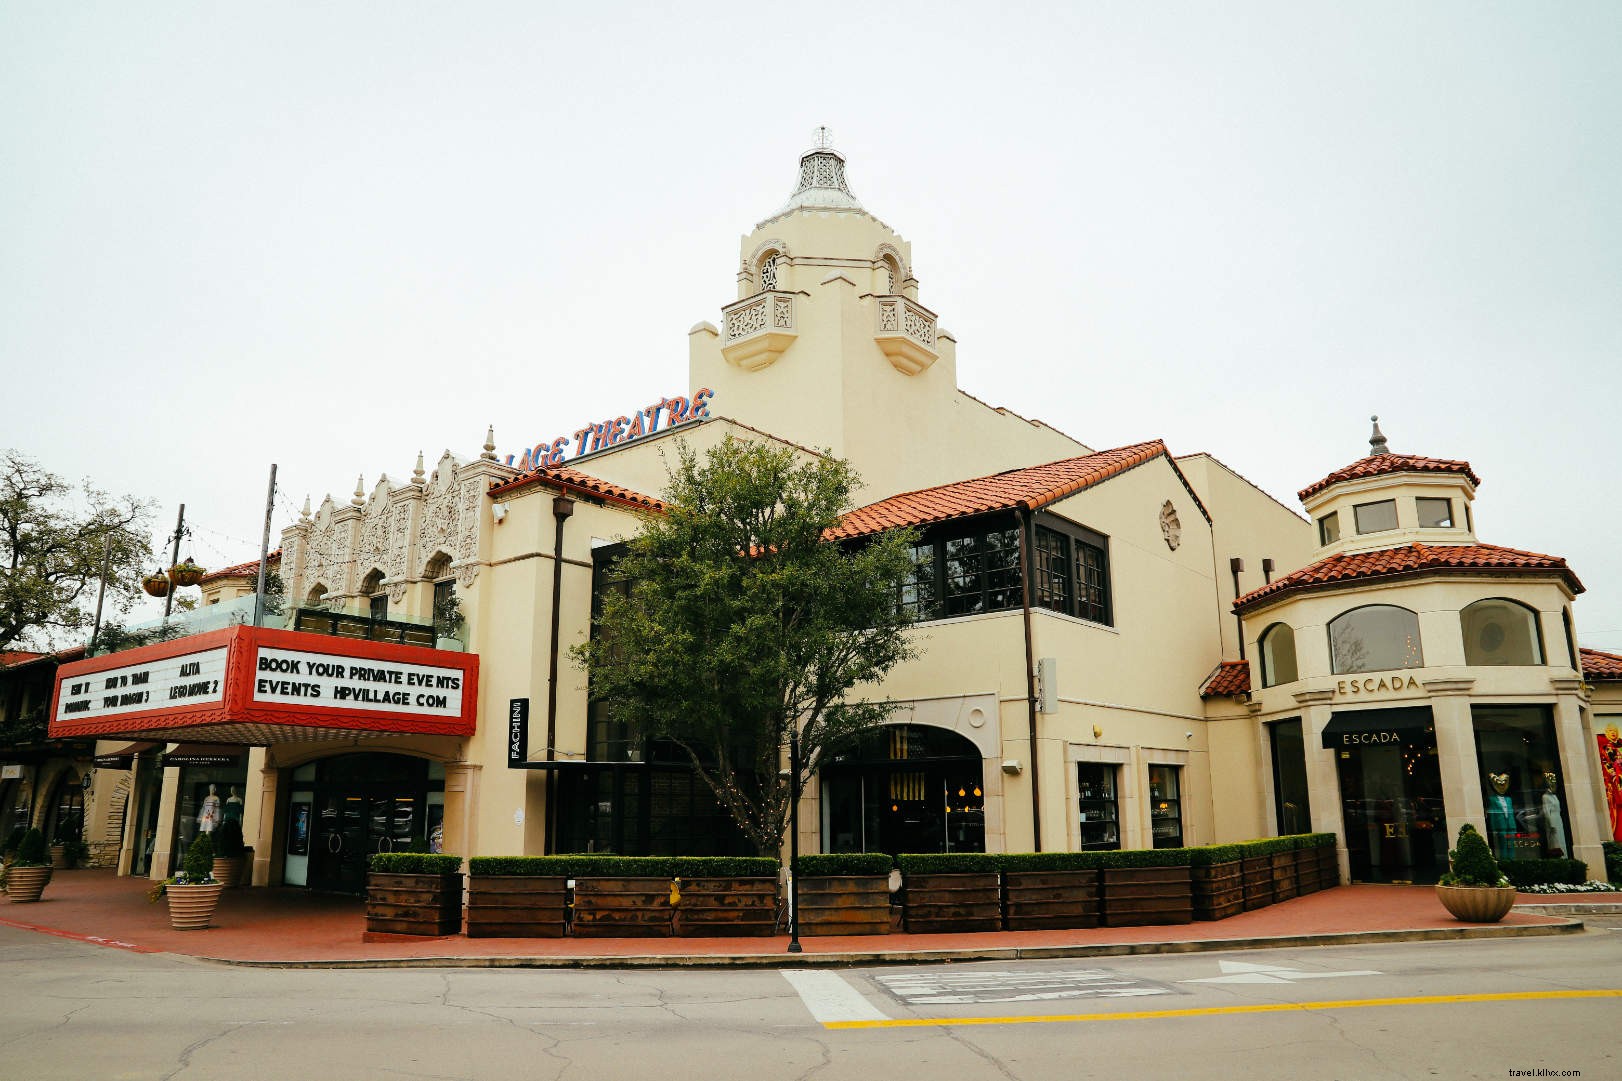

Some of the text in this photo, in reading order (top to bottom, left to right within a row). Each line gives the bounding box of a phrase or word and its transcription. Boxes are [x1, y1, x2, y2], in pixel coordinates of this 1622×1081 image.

[574, 387, 714, 456] THEATRE
[179, 661, 200, 678] ALITA
[257, 656, 301, 674] BOOK
[306, 661, 346, 679] YOUR
[349, 666, 403, 685] PRIVATE
[119, 674, 128, 688] TO
[169, 679, 219, 700] LEGO MOVIE 2
[257, 678, 321, 698] EVENTS
[1338, 676, 1419, 695] ESCADA
[144, 690, 150, 704] 3
[511, 702, 521, 759] FACHINI
[1343, 732, 1400, 745] ESCADA
